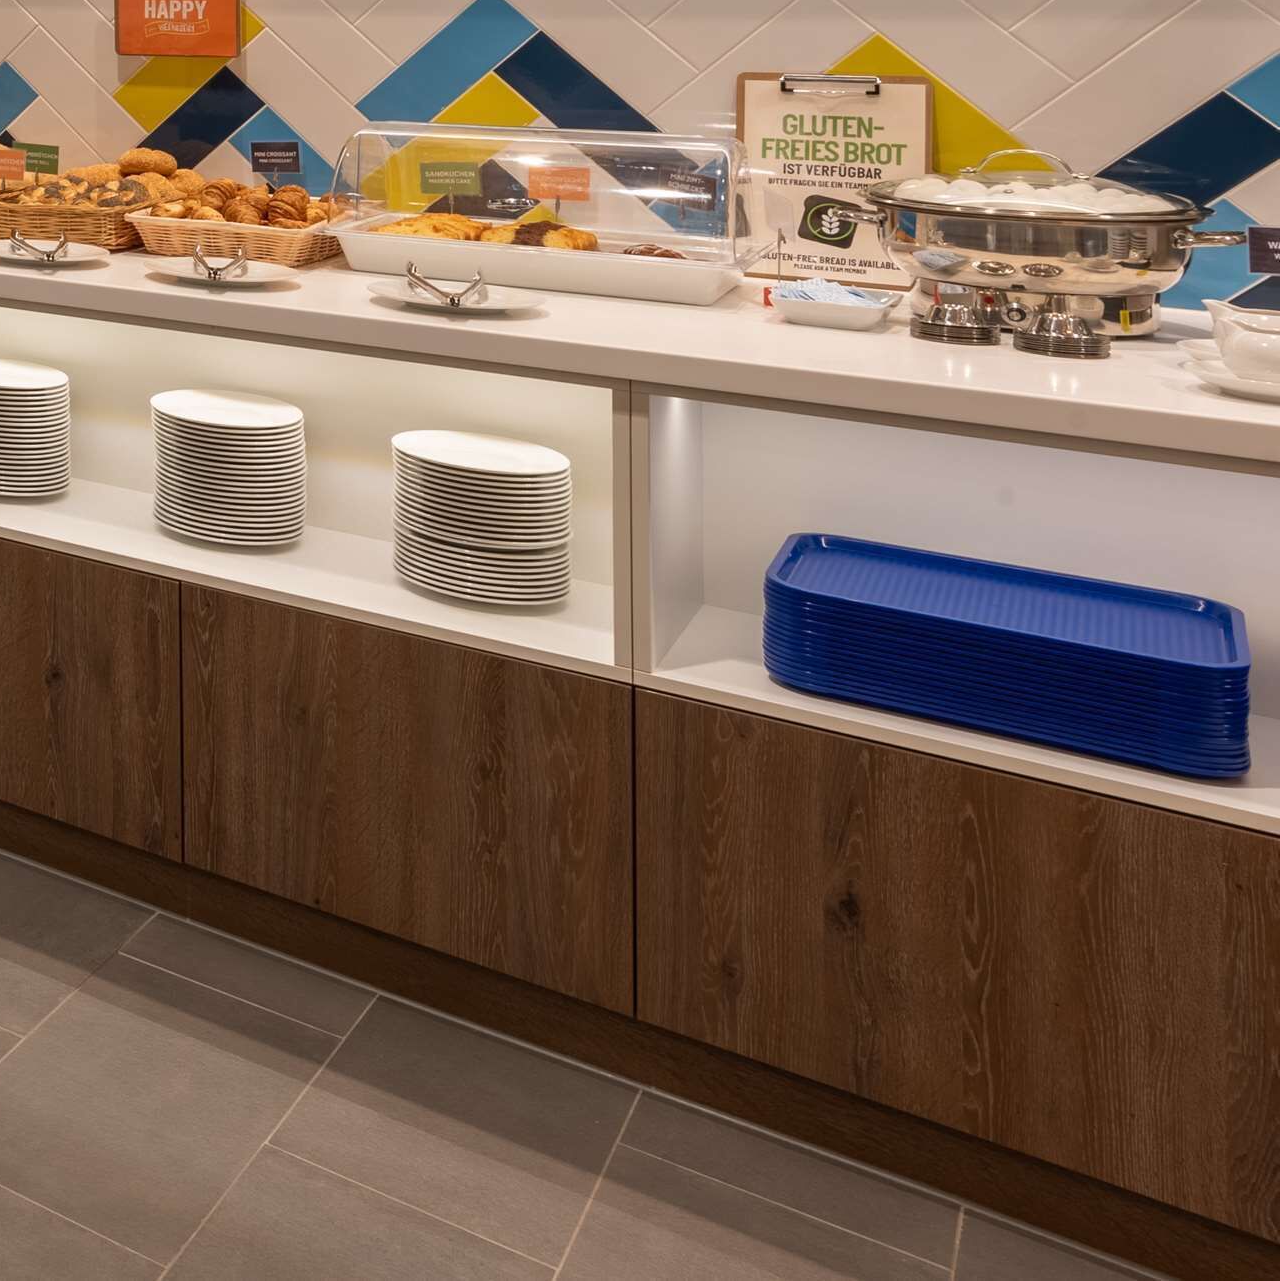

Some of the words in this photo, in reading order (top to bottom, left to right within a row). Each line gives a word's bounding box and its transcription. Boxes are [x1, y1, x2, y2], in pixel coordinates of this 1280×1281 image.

[144, 0, 207, 20] HAPPY
[782, 114, 884, 139] GLUTEN-
[761, 138, 839, 162] FREIES
[844, 141, 907, 166] BROT
[424, 170, 475, 178] SANDKUCHEN
[783, 163, 802, 174] IST
[806, 164, 882, 179] VERFÜGBAR
[789, 178, 816, 187] FRAGEN
[819, 256, 846, 265] BREAD
[848, 258, 857, 266] IS
